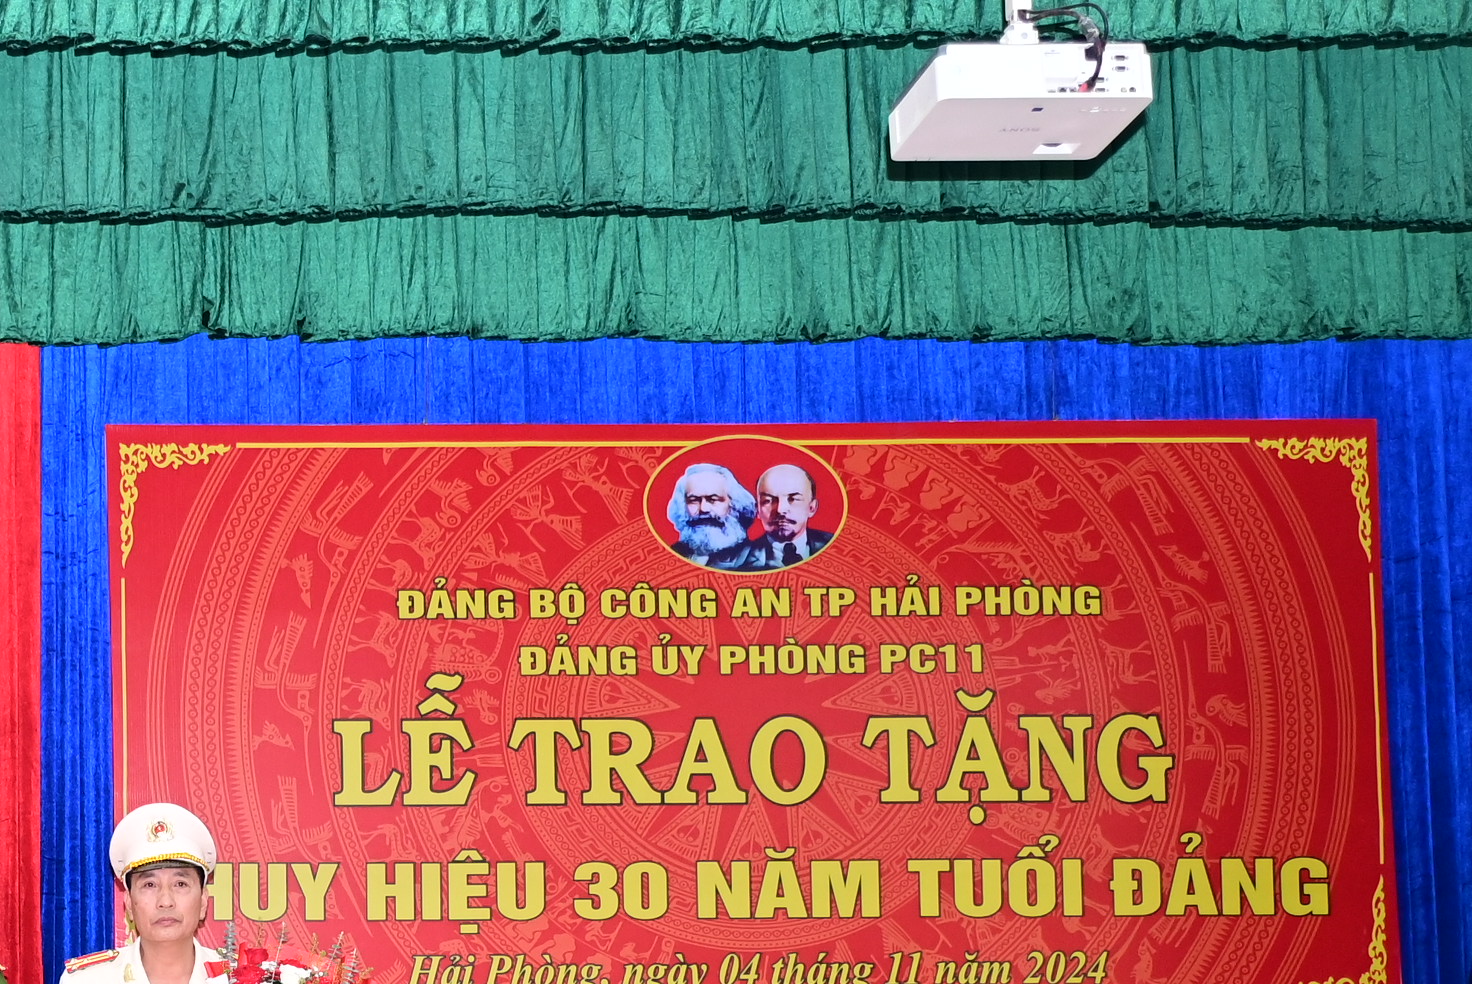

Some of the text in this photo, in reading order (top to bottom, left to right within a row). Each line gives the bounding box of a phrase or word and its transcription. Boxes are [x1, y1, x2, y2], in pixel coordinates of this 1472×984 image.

[397, 574, 1101, 625] ĐẢNG BỘ CÔNG AN TP HẢI PHÒNG
[520, 633, 982, 676] ĐẢNG ỦY PHÒNG PC11
[333, 673, 1173, 824] LỄ TRAO TẶNG
[368, 849, 545, 934] HIỆU
[575, 861, 668, 920] 30
[698, 848, 880, 919] NĂM
[909, 834, 1083, 918] TUỔI
[1111, 832, 1329, 916] ĐẢNG
[888, 952, 921, 984] 11
[936, 954, 1010, 984] năm
[1024, 951, 1108, 984] 2024
